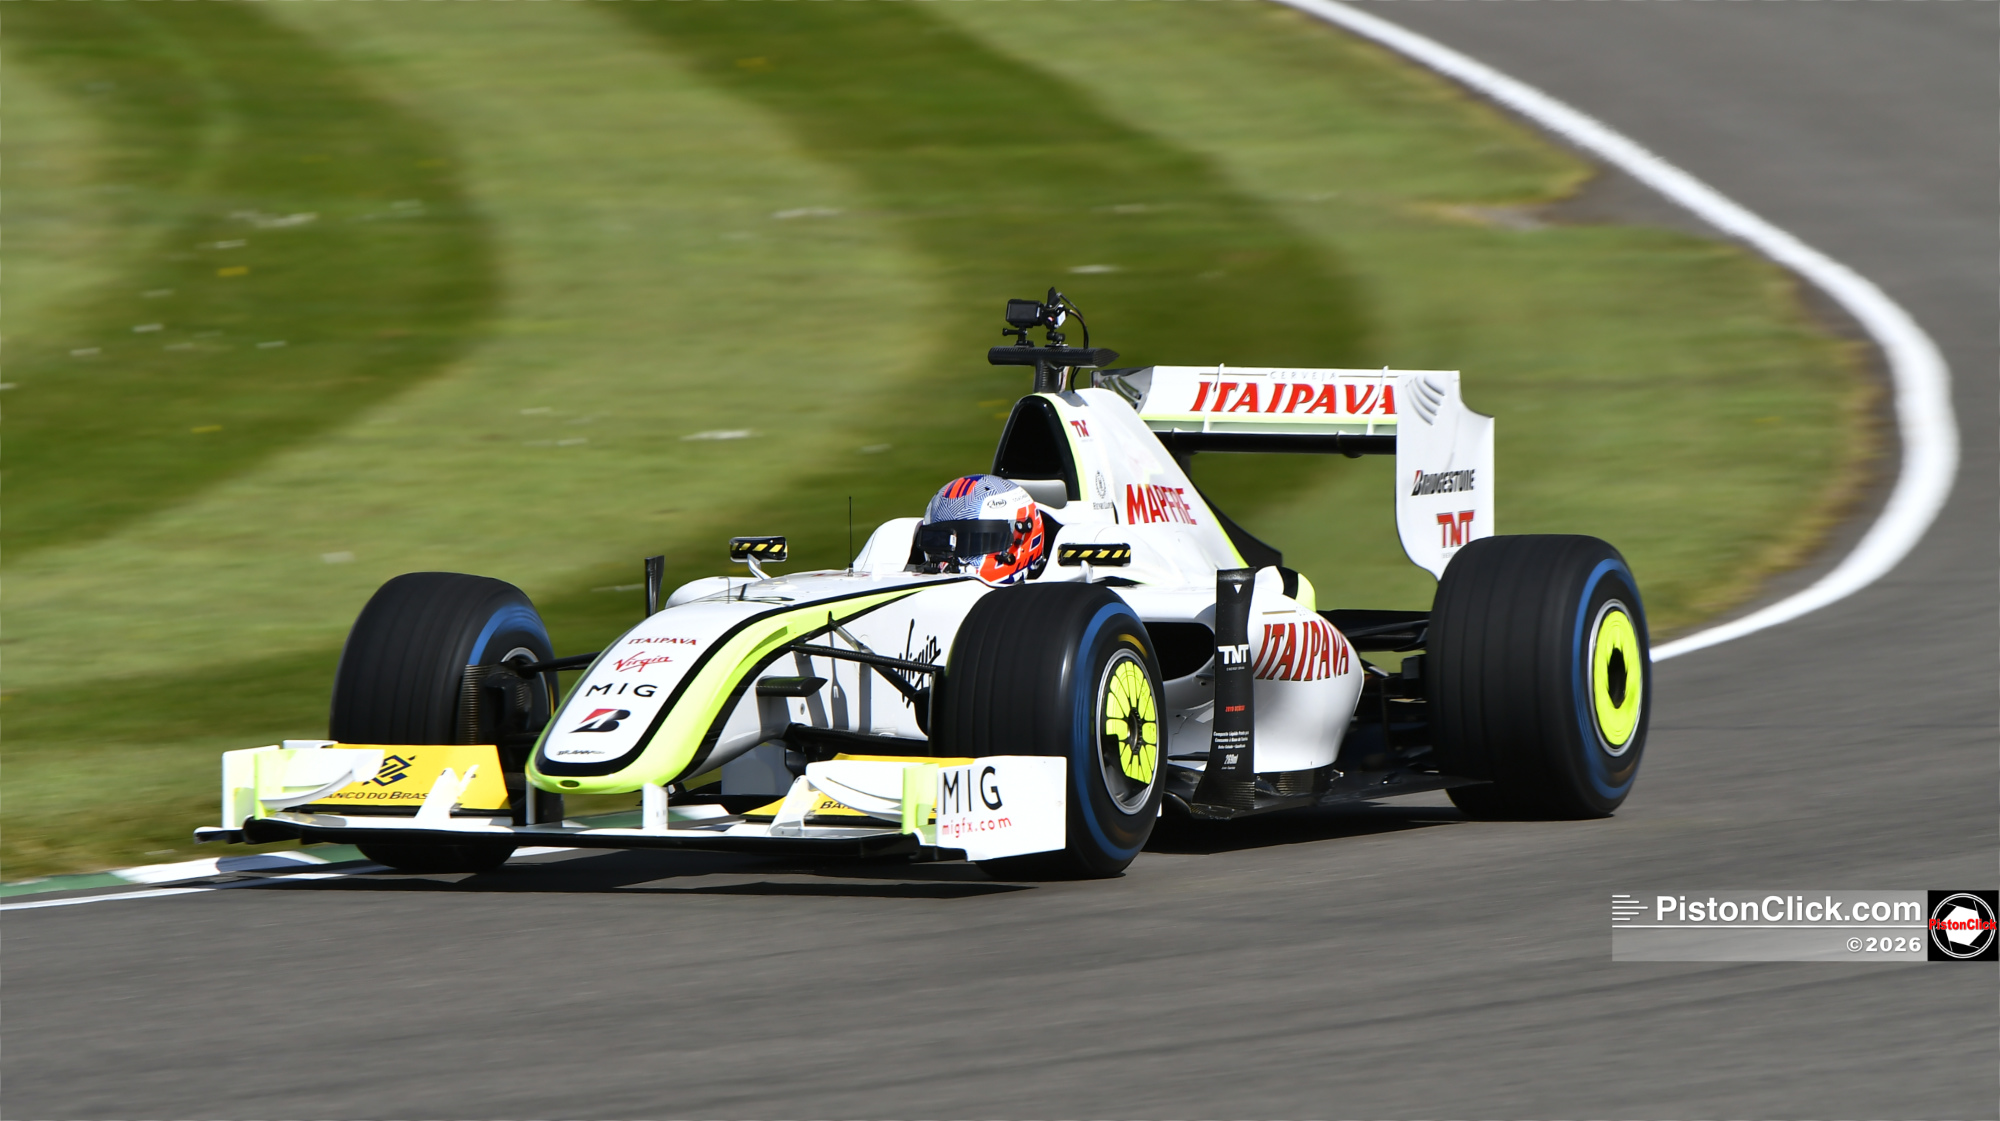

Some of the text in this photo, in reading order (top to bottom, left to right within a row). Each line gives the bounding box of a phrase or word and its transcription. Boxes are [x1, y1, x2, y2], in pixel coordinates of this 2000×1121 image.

[1270, 371, 1336, 381] CERVEJA
[1190, 381, 1397, 415] ITAIPAVA
[1126, 484, 1197, 525] MAPFRE
[1436, 510, 1475, 548] TNT
[627, 637, 697, 646] ITAIPAVA
[1252, 619, 1349, 682] ITAIPAVA
[613, 651, 673, 672] Virgin
[1217, 644, 1249, 664] TNT
[585, 682, 658, 697] MIG
[389, 791, 430, 799] BRAS
[943, 766, 1003, 815] MIG
[942, 815, 1012, 838] migfx.com
